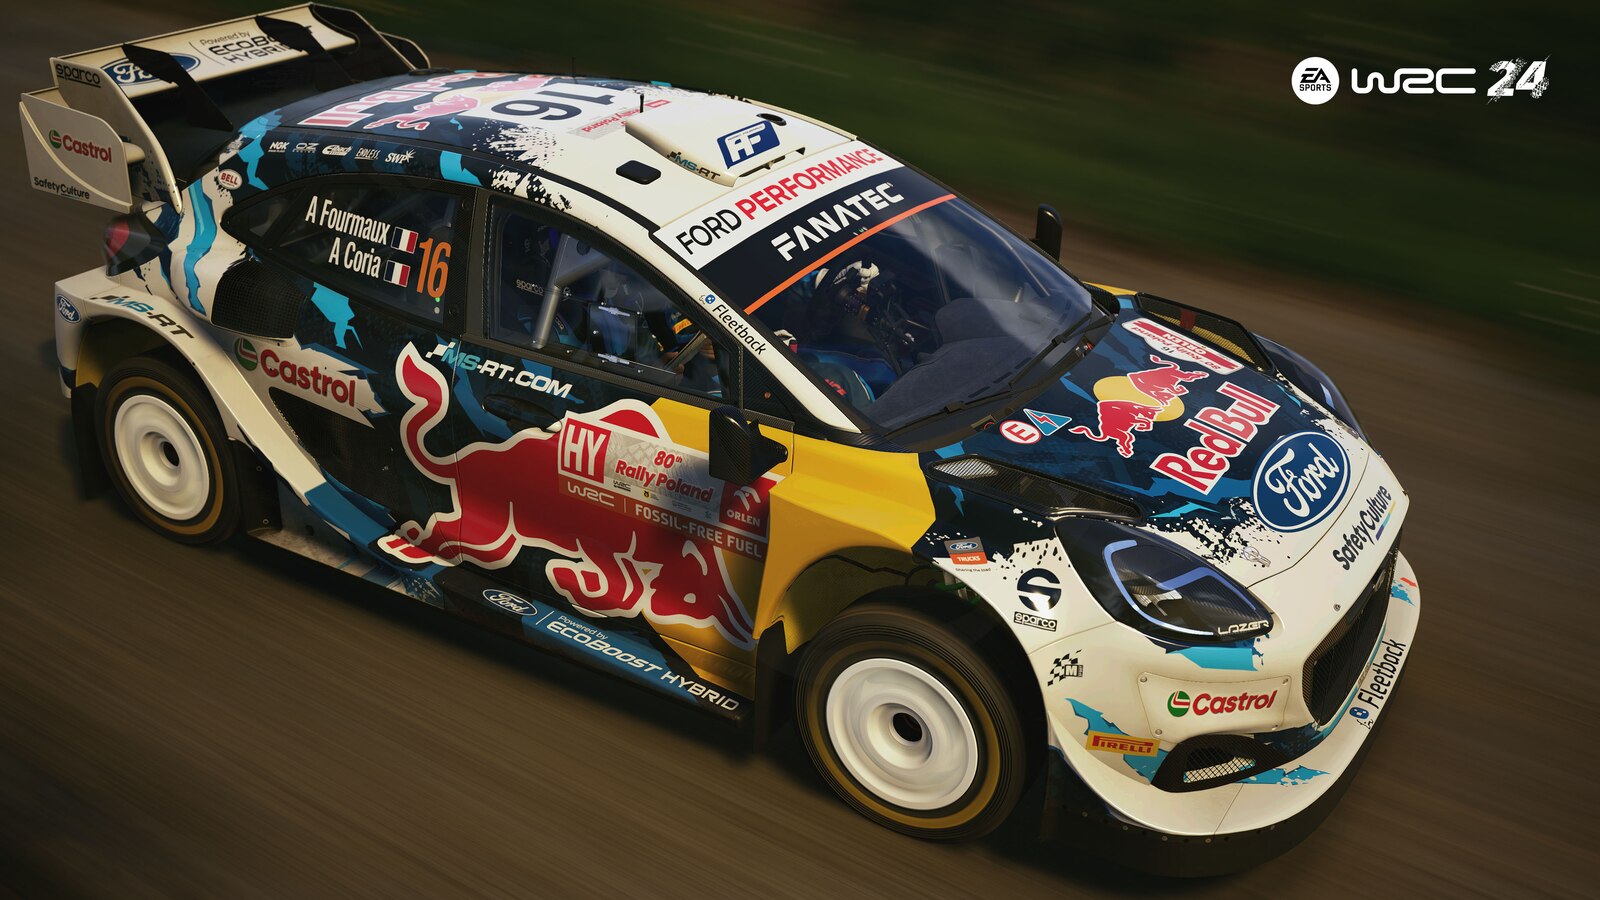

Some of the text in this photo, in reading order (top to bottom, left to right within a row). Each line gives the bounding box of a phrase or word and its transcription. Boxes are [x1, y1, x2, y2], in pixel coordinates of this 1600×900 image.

[200, 30, 251, 46] Powered by
[54, 63, 101, 88] sparco
[62, 134, 113, 163] Castrol
[269, 141, 290, 150] NGK
[295, 142, 320, 150] OZ
[354, 147, 381, 160] ENDLESS
[384, 152, 409, 164] SWP
[33, 176, 90, 200] SafetyCulture
[220, 172, 238, 185] BELL
[675, 148, 884, 255] FORD PERFORMANCE
[304, 195, 391, 246] A Fourmaux
[771, 181, 905, 262] FANATEC
[328, 237, 382, 279] A Coria
[416, 237, 452, 298] 16
[712, 304, 767, 356] Fleetback
[1162, 333, 1208, 355] ORLEN
[260, 348, 356, 407] Castrol
[1006, 422, 1036, 442] E
[1150, 381, 1281, 495] RedBull
[563, 424, 606, 477] HY
[615, 459, 714, 503] Rally Poland
[1264, 442, 1340, 518] Ford
[567, 481, 616, 507] WRC
[634, 503, 762, 559] FOSSIL-FREE FUEL
[726, 508, 761, 528] ORLEN
[1332, 485, 1392, 571] SafetyCulture
[488, 591, 529, 614] Ford
[557, 614, 609, 641] Powered by
[1014, 612, 1057, 631] sparco
[1217, 619, 1270, 635] LAZER
[546, 620, 740, 712] ECOBOOST HYBRID
[1357, 638, 1407, 710] Fleetback
[1192, 689, 1279, 717] Castrol
[1092, 735, 1154, 753] PIRELLI
